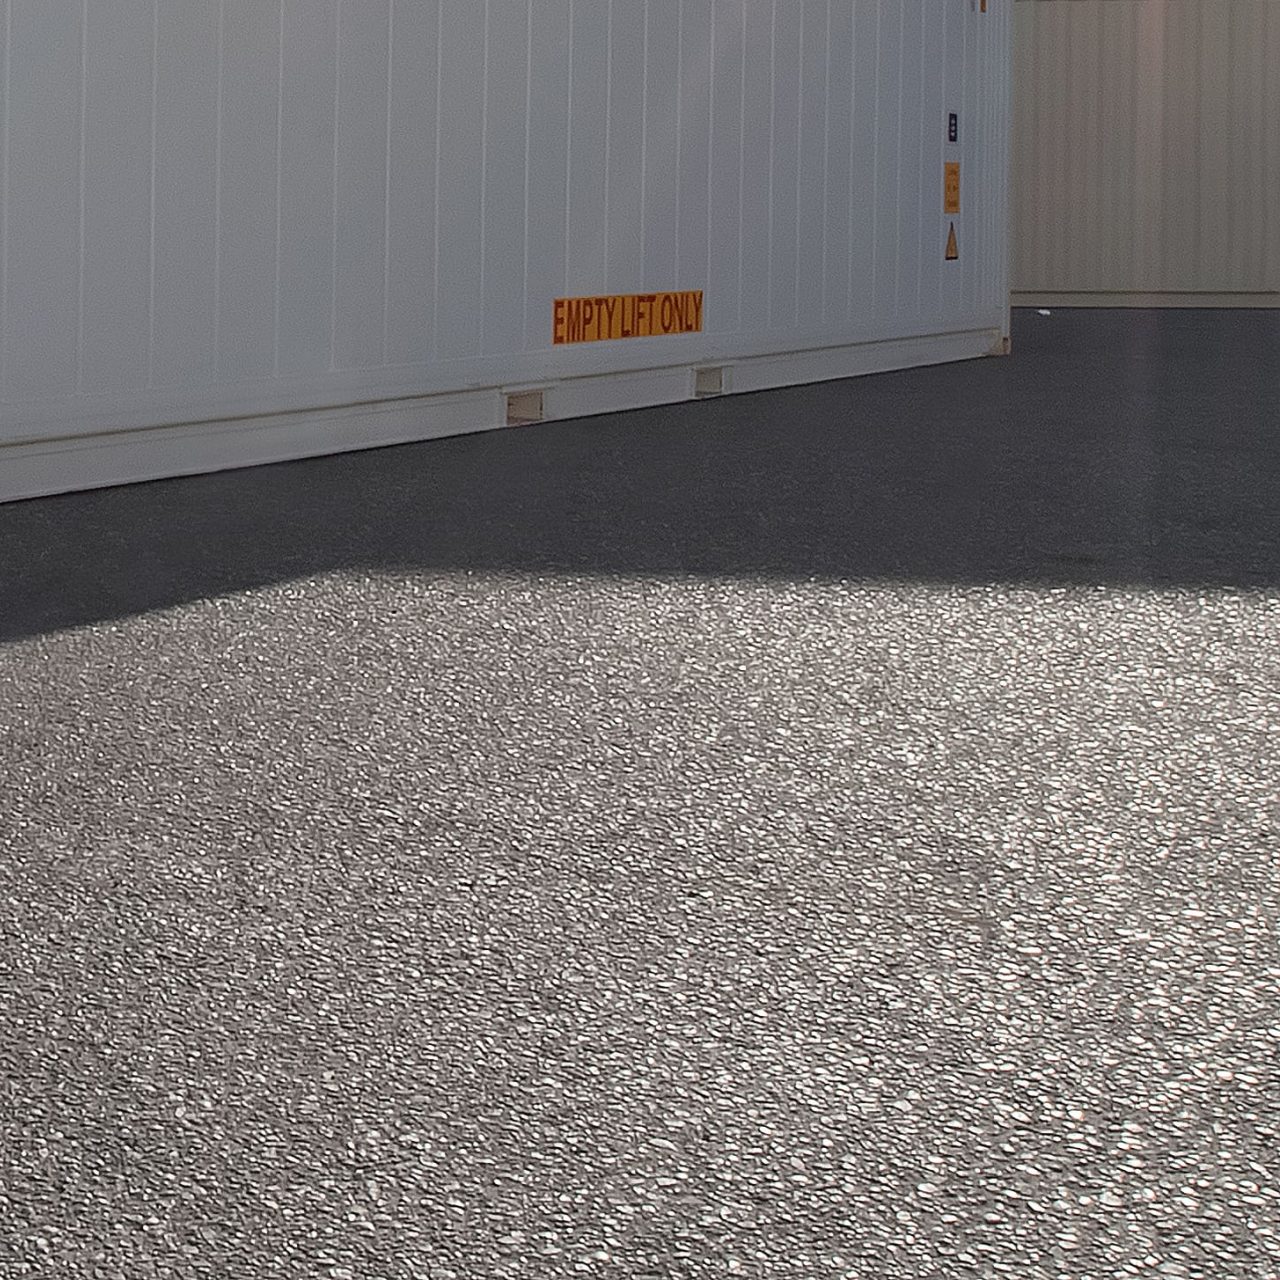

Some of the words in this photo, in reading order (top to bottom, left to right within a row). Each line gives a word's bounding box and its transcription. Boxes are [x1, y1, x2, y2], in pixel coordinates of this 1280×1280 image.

[554, 297, 616, 344] EMPTY
[621, 294, 657, 338] LIFT
[660, 291, 703, 334] ONLY
